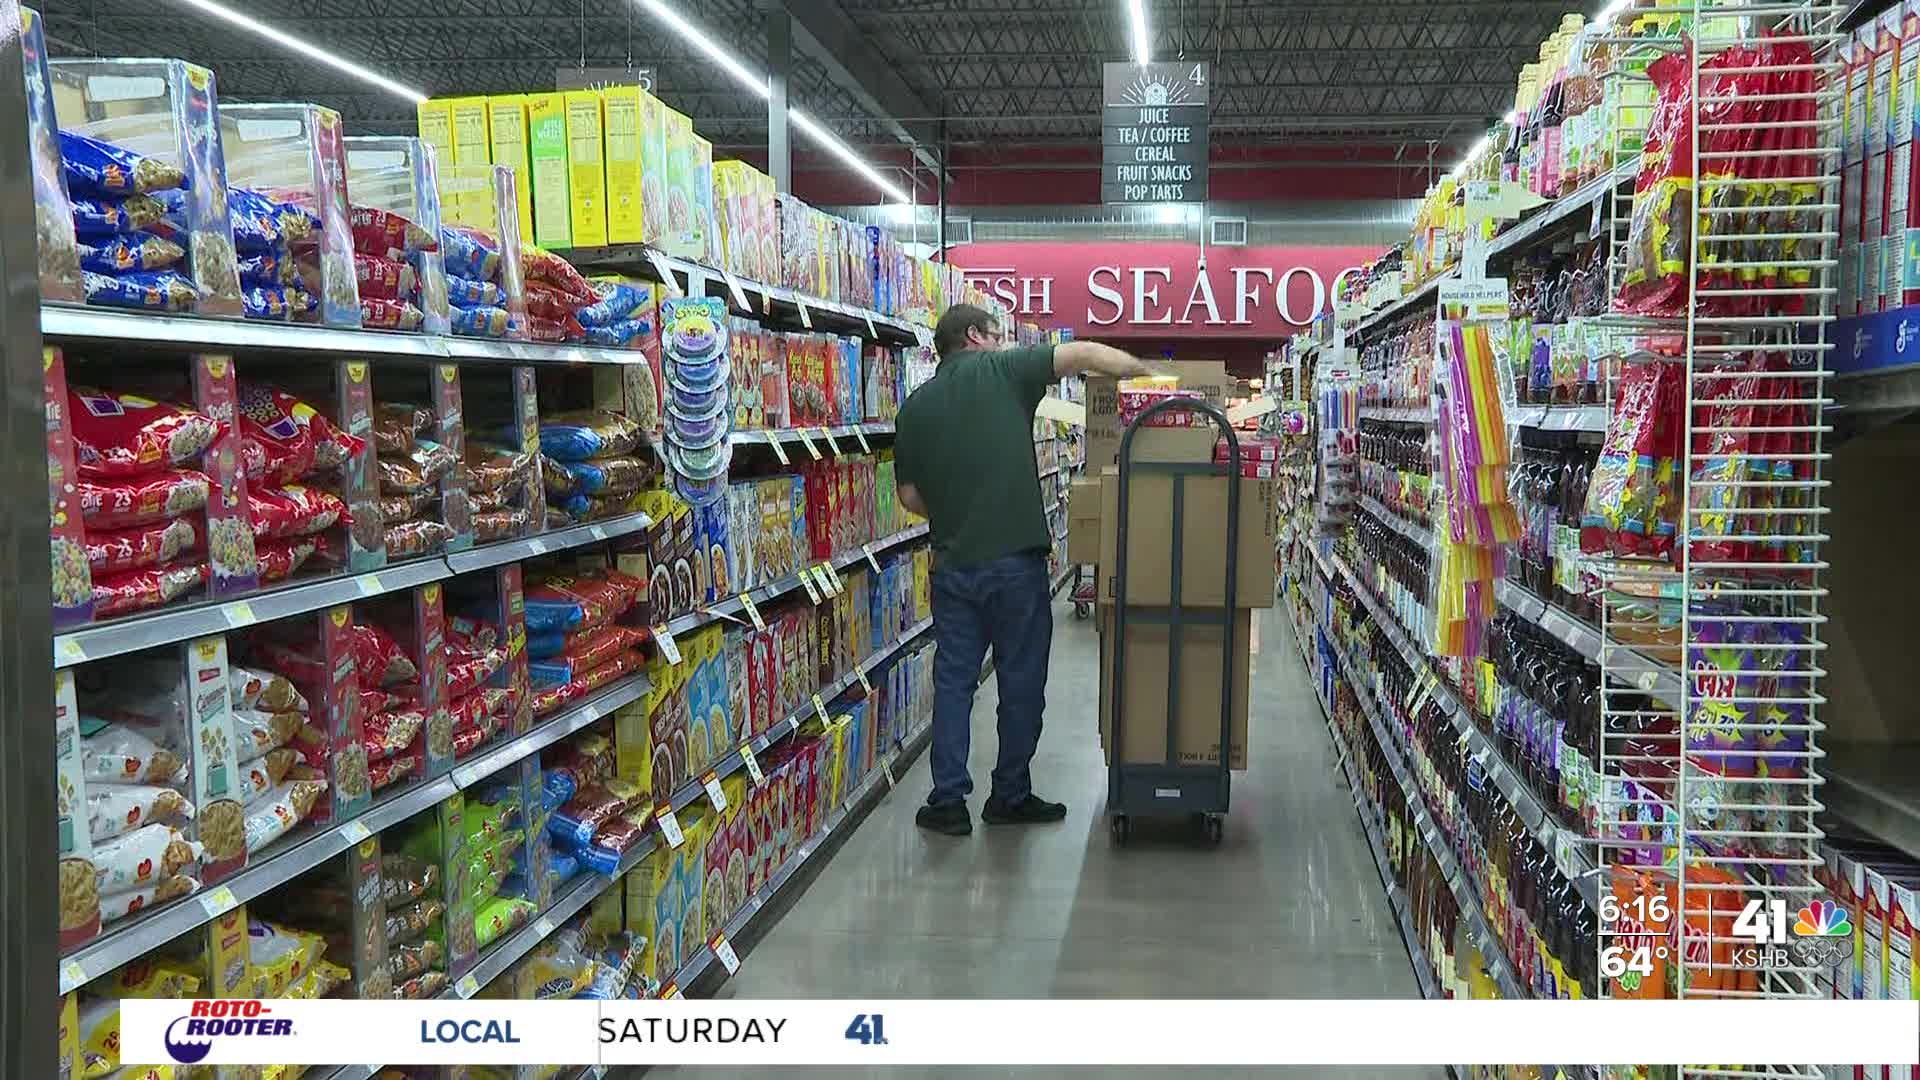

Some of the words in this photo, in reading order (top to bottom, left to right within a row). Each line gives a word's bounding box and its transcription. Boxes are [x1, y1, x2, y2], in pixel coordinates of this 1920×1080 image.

[638, 69, 651, 90] 5
[1189, 63, 1205, 86] 4
[1139, 108, 1169, 124] JUICE
[1118, 127, 1139, 143] TEA
[1141, 127, 1148, 144] /
[1150, 127, 1191, 143] COFFEE
[1135, 146, 1176, 162] CEREAL
[1117, 165, 1149, 181] FRUIT
[1151, 165, 1192, 181] SNACKS
[1125, 184, 1148, 201] POP
[1150, 184, 1184, 201] TARTS
